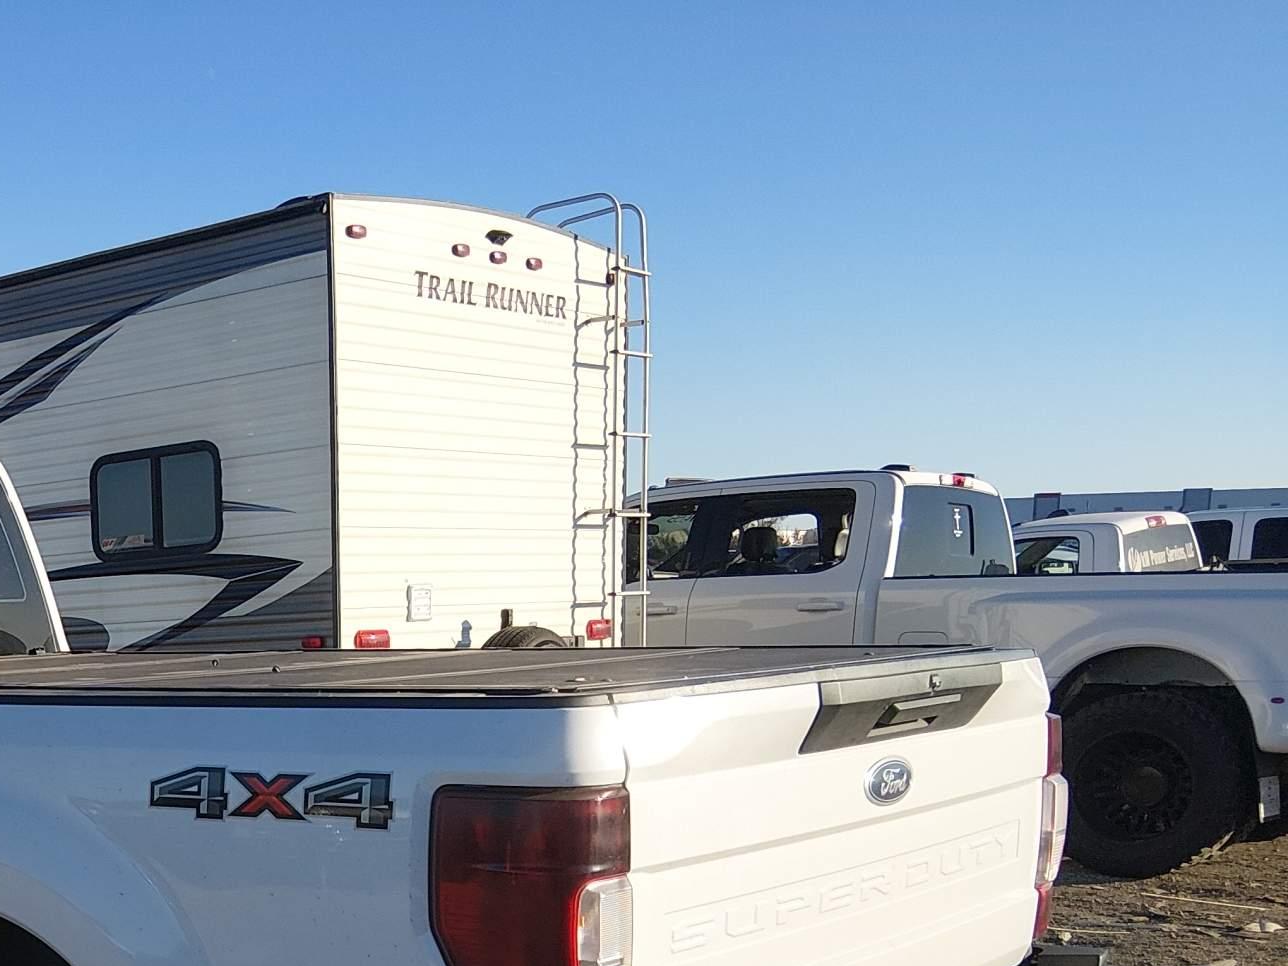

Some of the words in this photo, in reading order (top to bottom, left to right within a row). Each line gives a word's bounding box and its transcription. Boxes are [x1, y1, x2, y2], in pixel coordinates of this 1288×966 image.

[414, 270, 477, 306] TRAIL
[485, 282, 567, 319] RUNNER
[669, 872, 892, 955] SUPER
[904, 833, 1009, 890] DUTY
